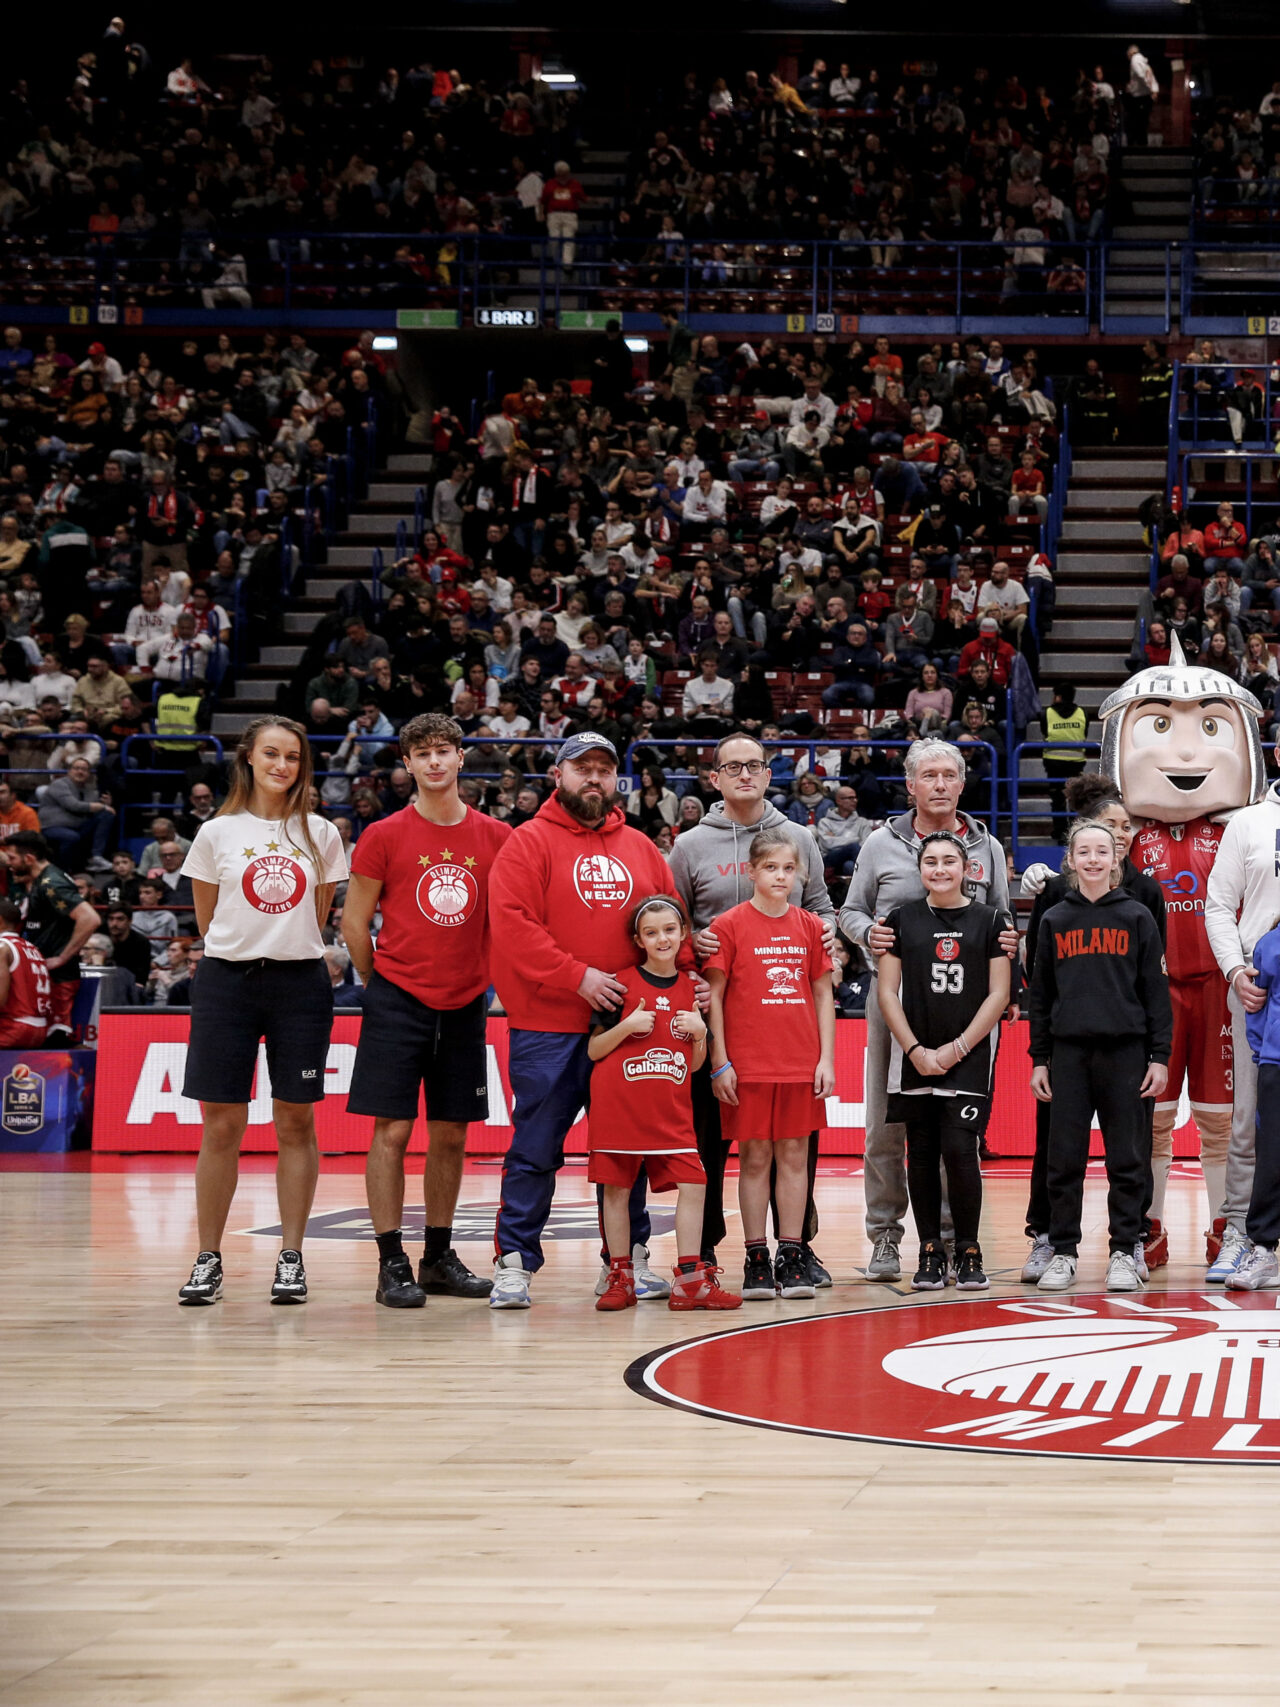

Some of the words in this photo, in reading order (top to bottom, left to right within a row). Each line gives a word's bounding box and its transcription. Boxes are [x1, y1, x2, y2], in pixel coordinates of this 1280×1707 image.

[491, 310, 524, 325] BAR
[817, 317, 833, 328] 20
[1139, 829, 1160, 843] EA7
[254, 857, 293, 869] OLIMPIA
[430, 867, 466, 880] OLIMPIA
[584, 890, 626, 900] MELZO
[258, 901, 293, 913] MILANO
[433, 912, 466, 924] MILANO
[1055, 927, 1130, 959] MILANO
[931, 962, 965, 994] 53
[302, 1069, 317, 1078] EA7
[627, 1061, 684, 1079] Galbanetto
[476, 1086, 486, 1096] EA7
[9, 1092, 39, 1104] LBA
